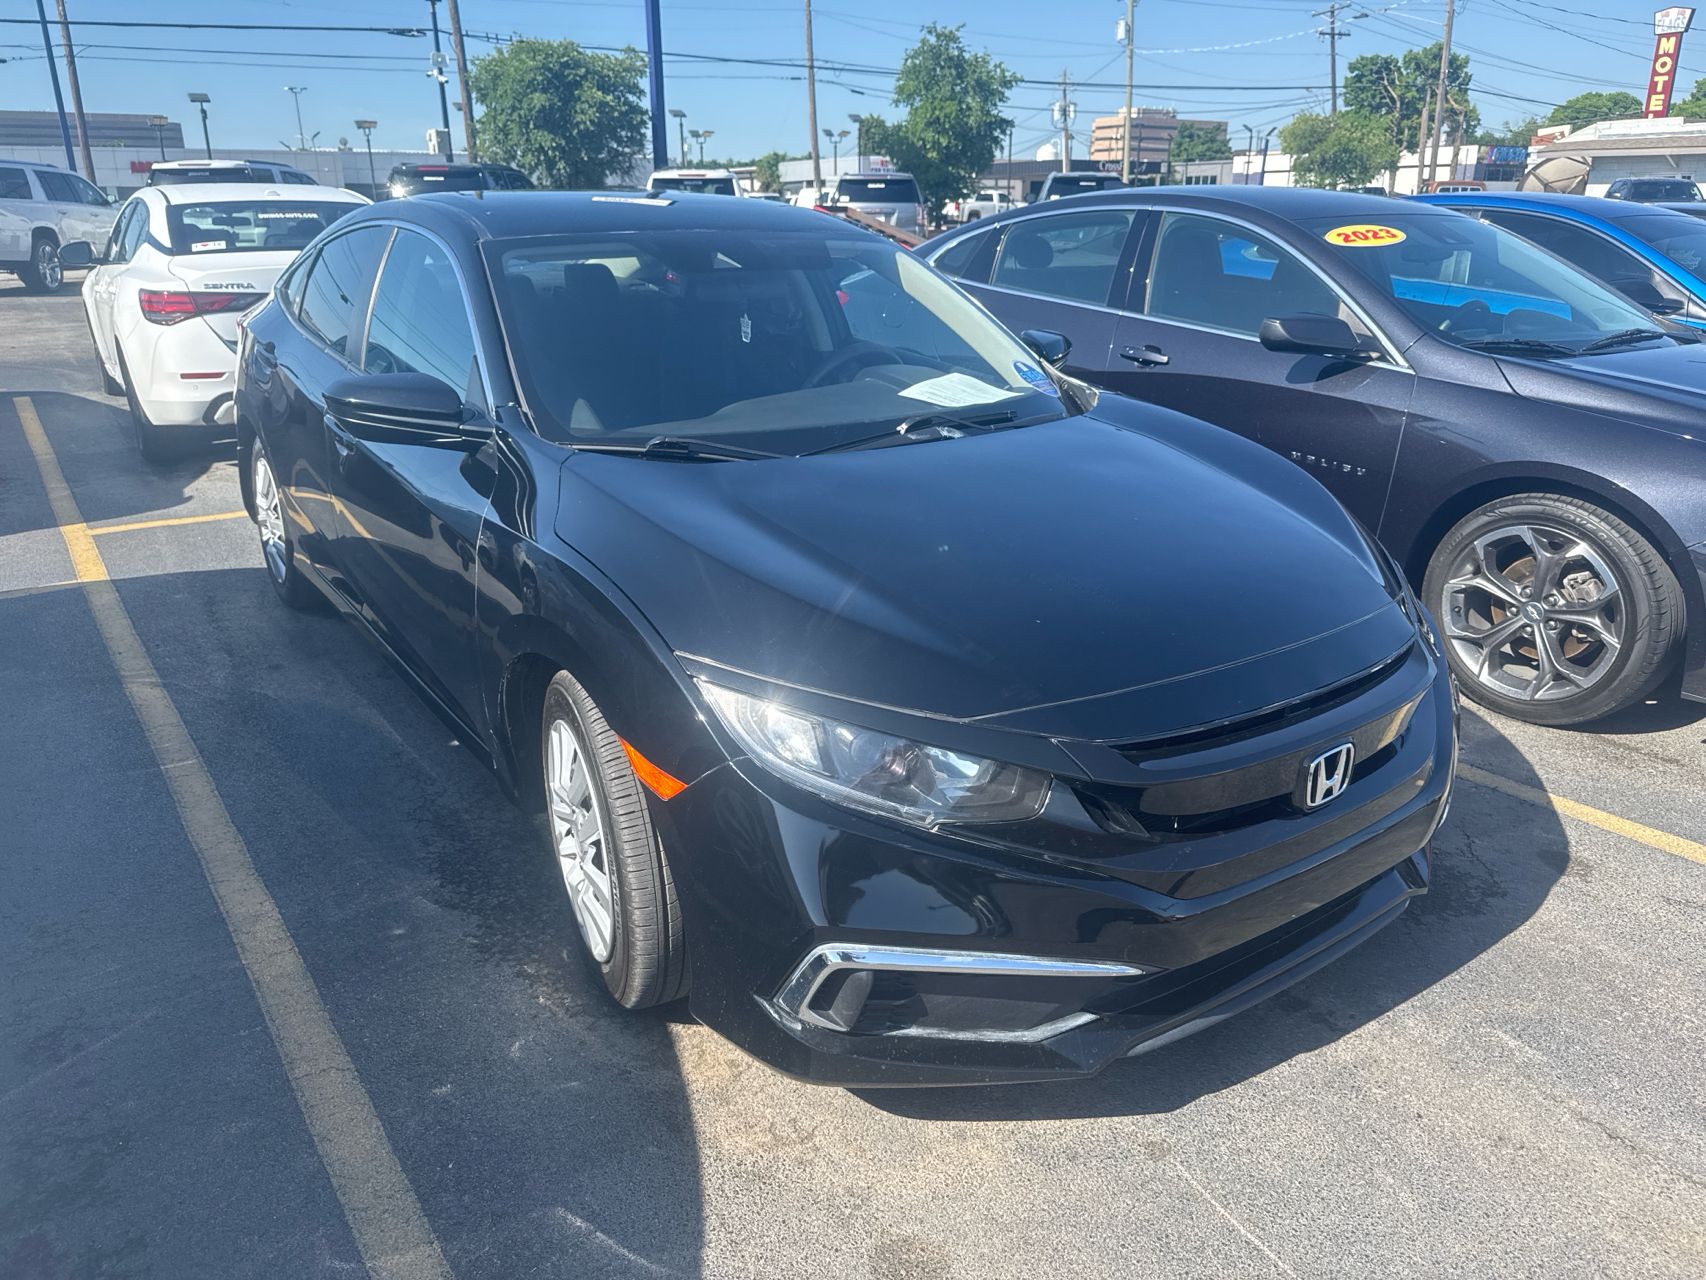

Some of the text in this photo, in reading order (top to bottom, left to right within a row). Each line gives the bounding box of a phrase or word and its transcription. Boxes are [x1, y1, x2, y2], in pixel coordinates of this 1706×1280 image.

[1648, 36, 1676, 119] MOTE
[1336, 228, 1398, 243] 2023
[203, 282, 256, 291] SENTRA
